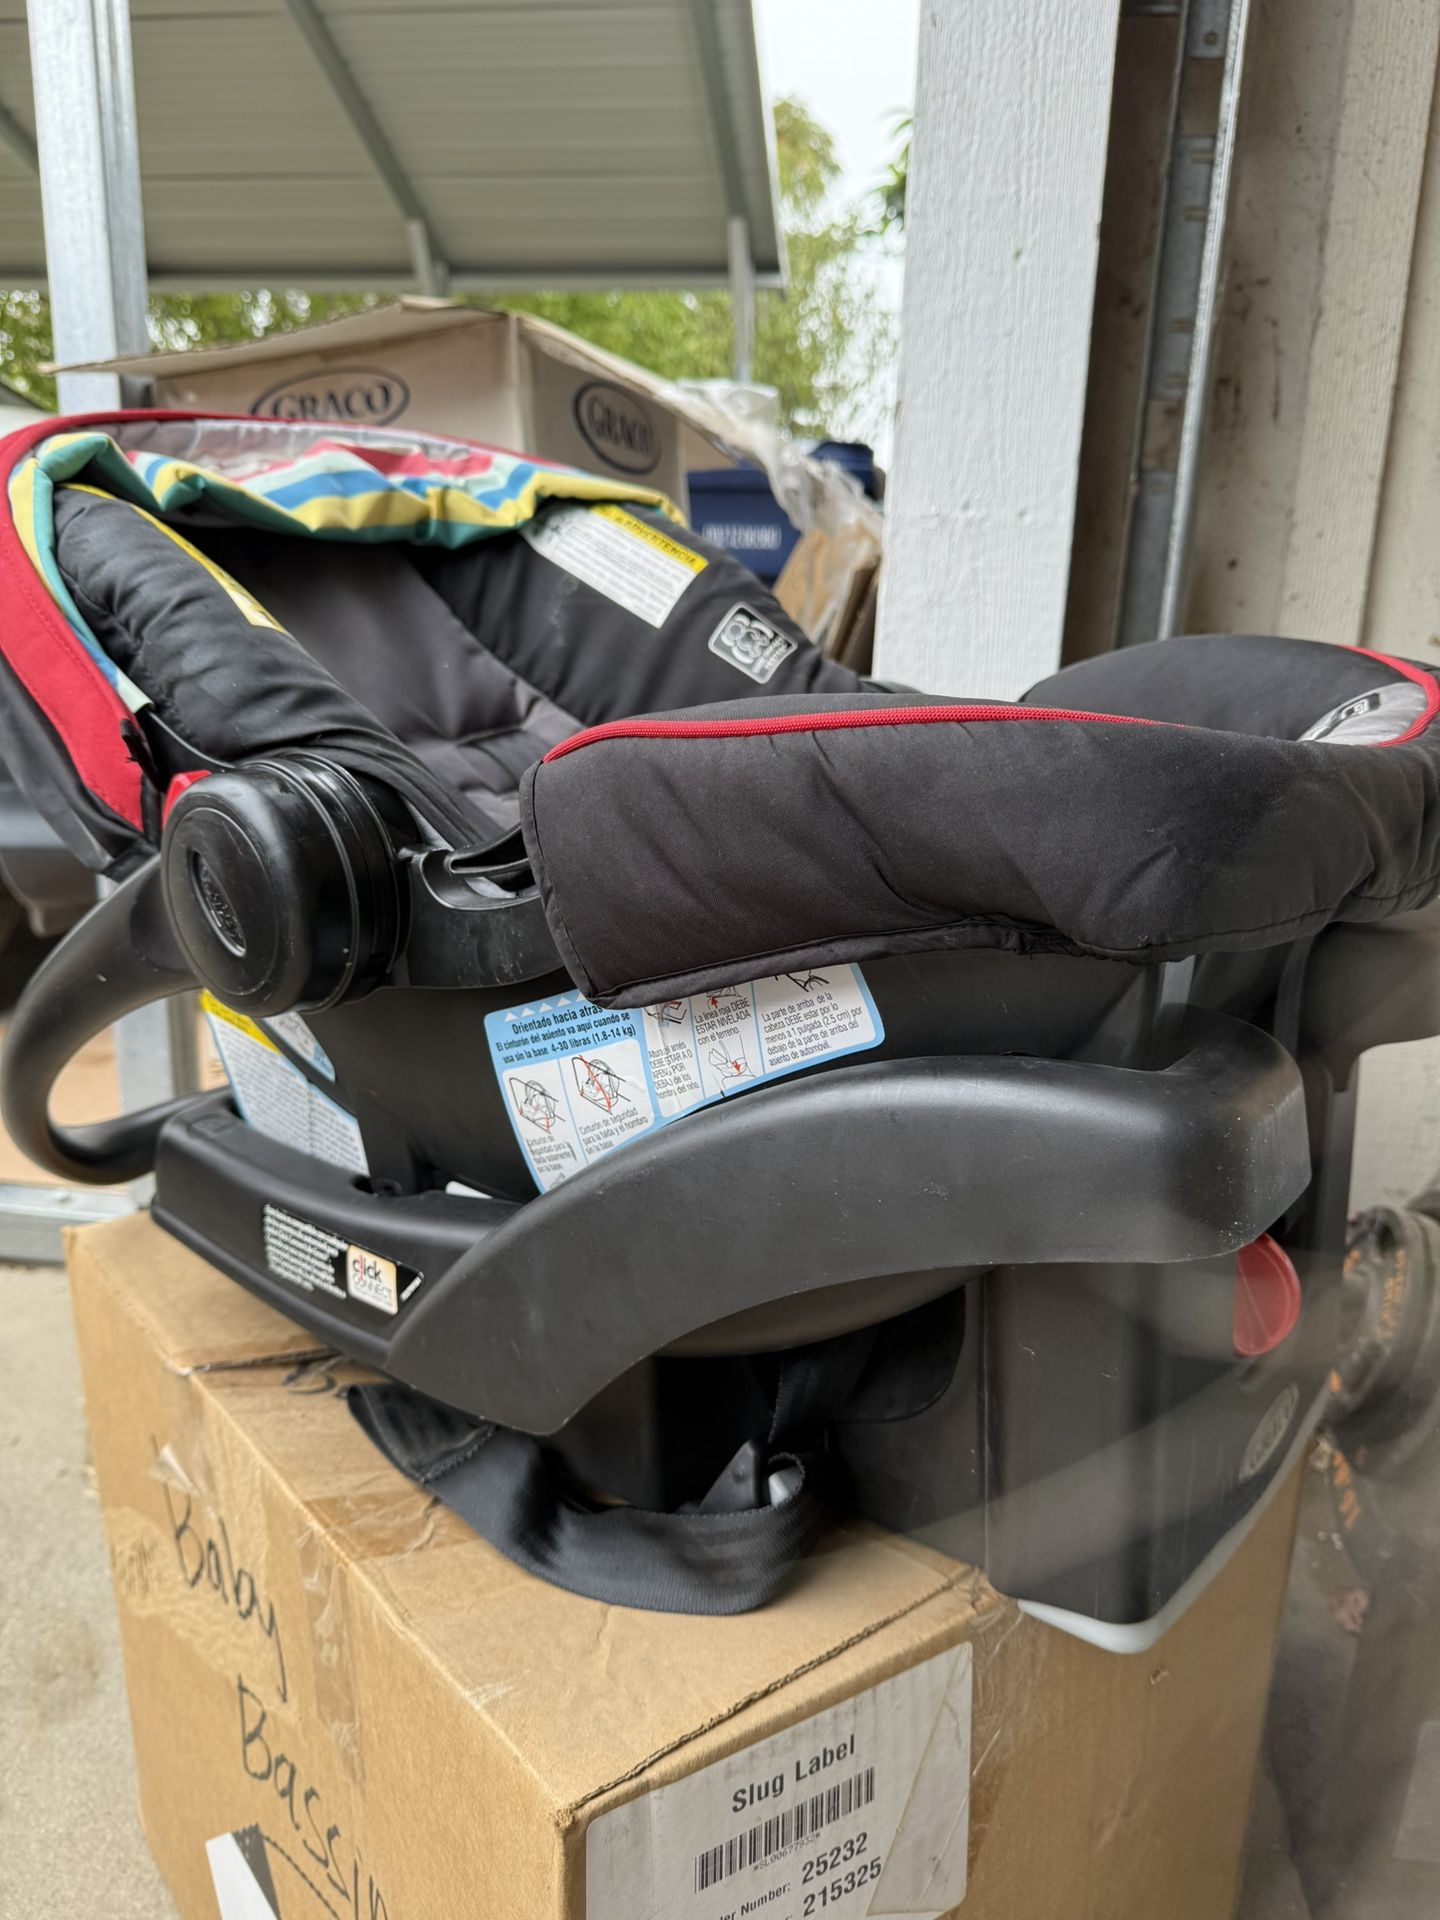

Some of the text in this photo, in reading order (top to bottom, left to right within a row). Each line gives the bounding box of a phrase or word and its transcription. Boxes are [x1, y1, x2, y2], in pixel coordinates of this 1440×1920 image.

[272, 381, 391, 422] GRACO
[512, 1016, 552, 1035] Orientado
[553, 1009, 578, 1025] hacia
[694, 1013, 704, 1024] La
[719, 1005, 731, 1016] roja
[730, 997, 751, 1011] DEBE
[695, 1009, 752, 1035] ESTAR NIVELADA
[761, 992, 833, 1022] La parte de arriba de la
[764, 1002, 839, 1033] cabeza DEBE estar por lo
[496, 1042, 504, 1052] El
[530, 1032, 541, 1044] del
[541, 1027, 566, 1043] asiento
[567, 1025, 576, 1035] va
[593, 1013, 620, 1028] cuando
[620, 1011, 631, 1021] se
[697, 1036, 711, 1046] con
[710, 1032, 717, 1041] el
[765, 1031, 787, 1044] menos
[797, 1020, 823, 1036] pulgada
[837, 1009, 850, 1022] cm)
[851, 1006, 863, 1019] por
[767, 1042, 788, 1056] debajo
[787, 1039, 796, 1049] de
[796, 1037, 803, 1046] la
[803, 1033, 820, 1045] parte
[820, 1030, 829, 1039] de
[848, 1017, 859, 1029] del
[502, 1024, 637, 1064] usa sin la base 4-30 libras (1.8-14 kg)
[768, 1054, 791, 1067] asiento
[790, 1049, 800, 1060] de
[671, 1062, 686, 1075] POR
[610, 1107, 639, 1125] seguridad
[352, 1254, 383, 1283] click
[152, 1434, 287, 1703] Baby
[732, 1733, 855, 1814] Slug Label
[740, 1831, 868, 1917] Number: 25232
[803, 1856, 883, 1918] 215325
